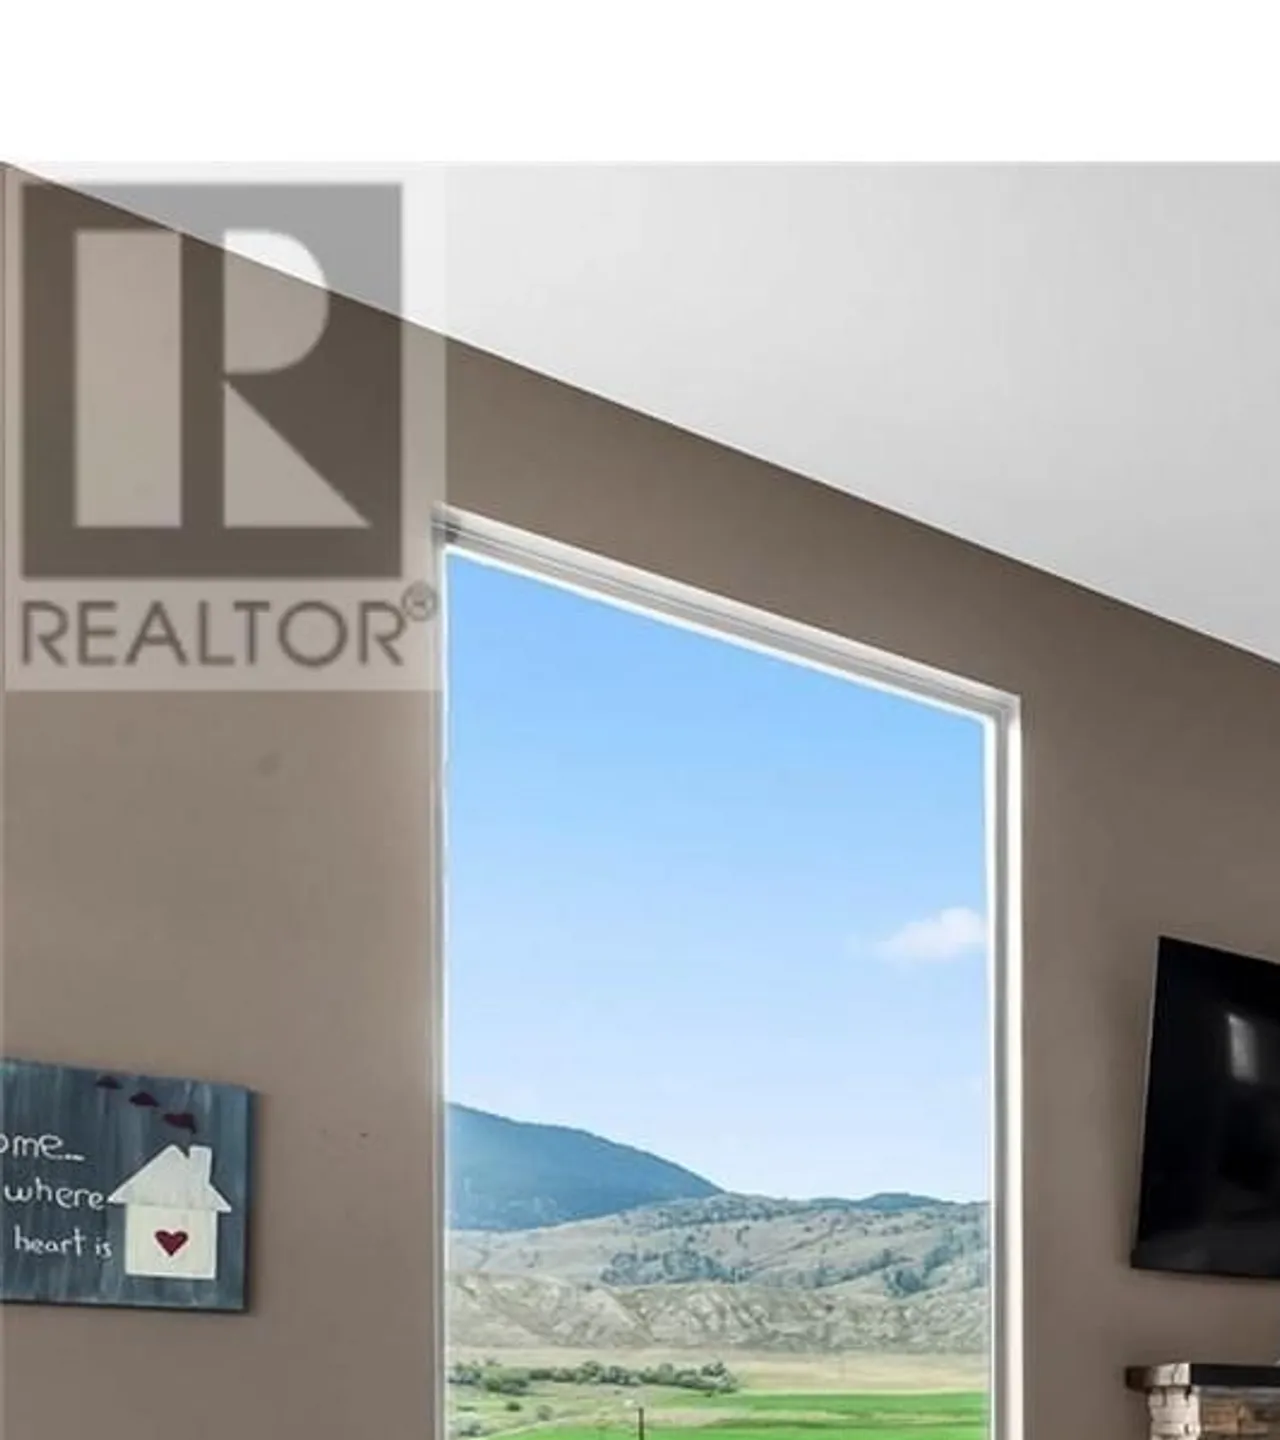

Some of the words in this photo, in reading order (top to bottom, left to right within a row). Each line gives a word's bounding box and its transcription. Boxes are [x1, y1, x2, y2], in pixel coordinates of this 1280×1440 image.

[4, 1176, 104, 1211] where
[14, 1224, 86, 1257] heart
[95, 1236, 112, 1259] is
